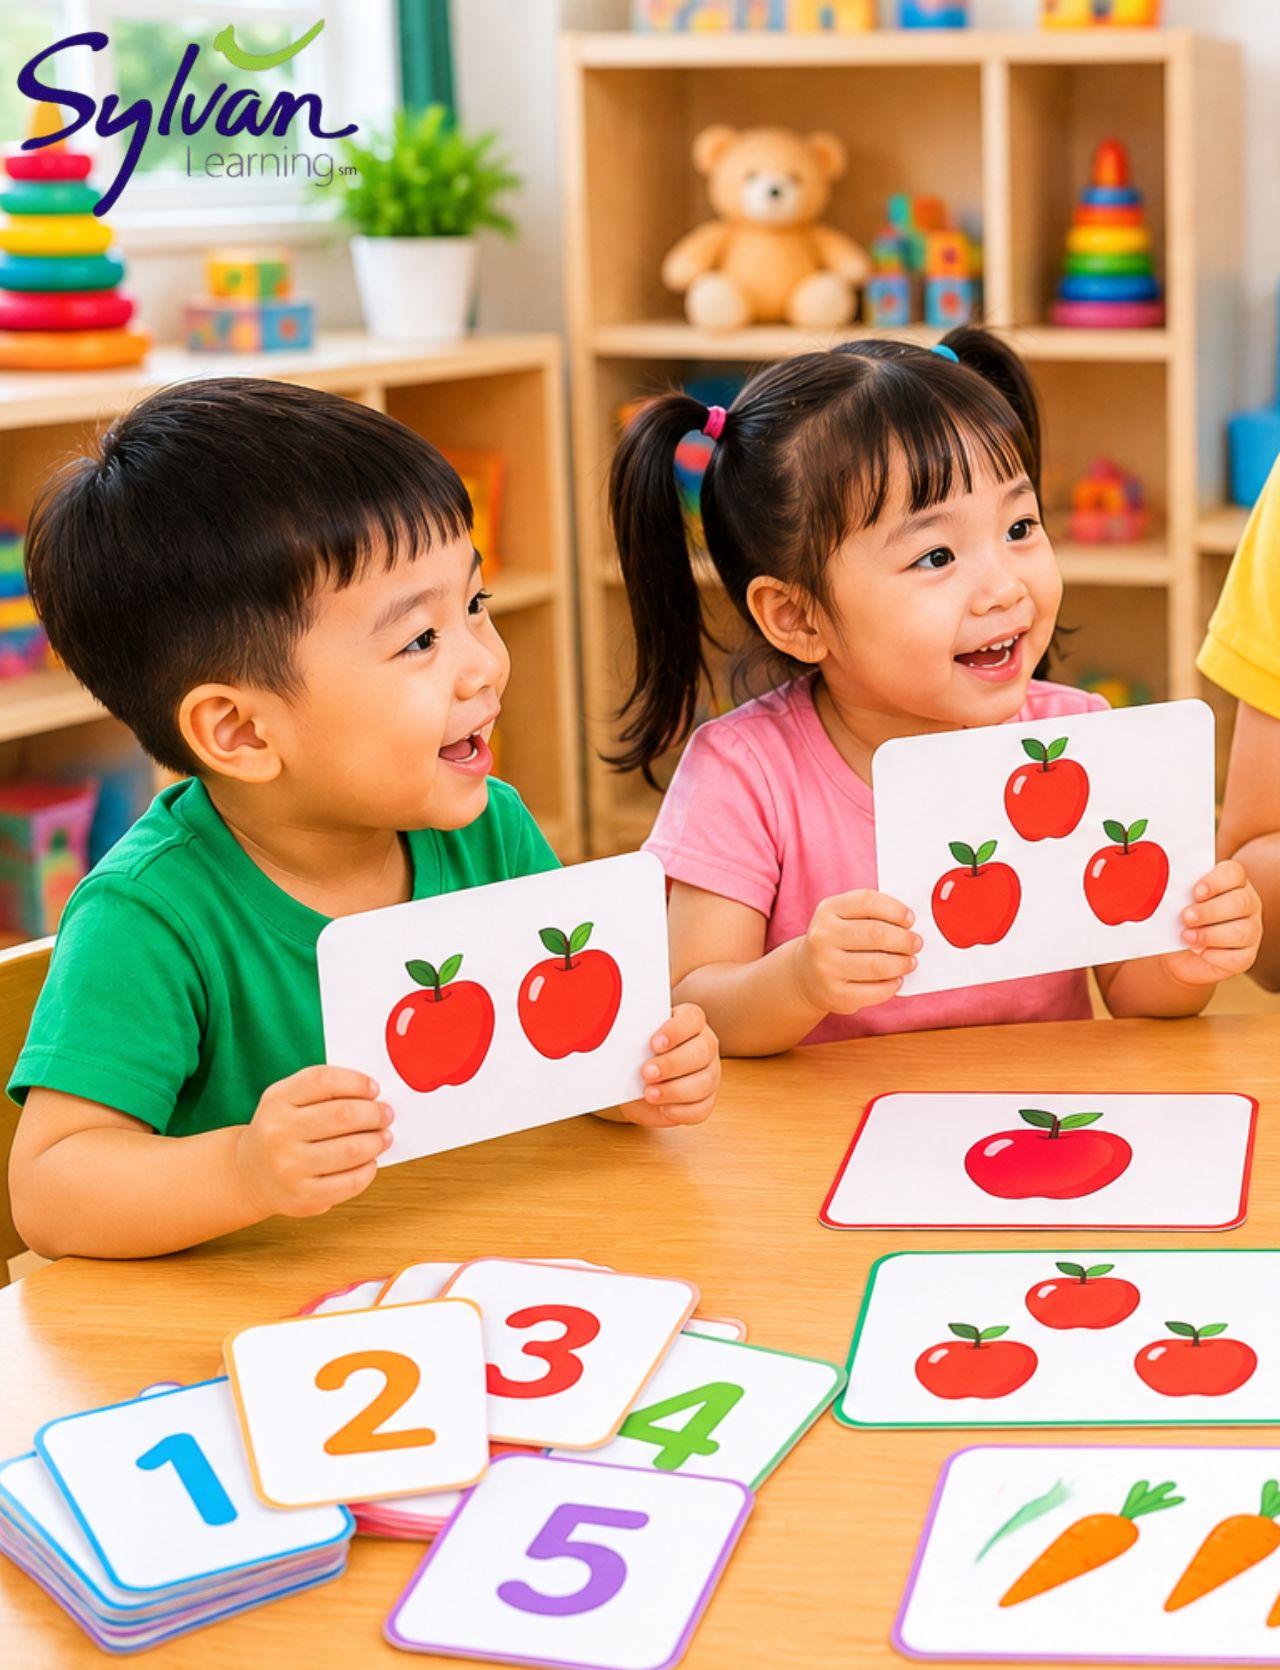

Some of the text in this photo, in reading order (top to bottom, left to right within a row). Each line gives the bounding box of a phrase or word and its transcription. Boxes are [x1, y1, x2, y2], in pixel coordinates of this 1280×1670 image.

[485, 1304, 601, 1400] 3
[314, 1349, 437, 1457] 2
[619, 1381, 746, 1472] 4
[135, 1432, 239, 1528] 1
[496, 1502, 650, 1618] 5
